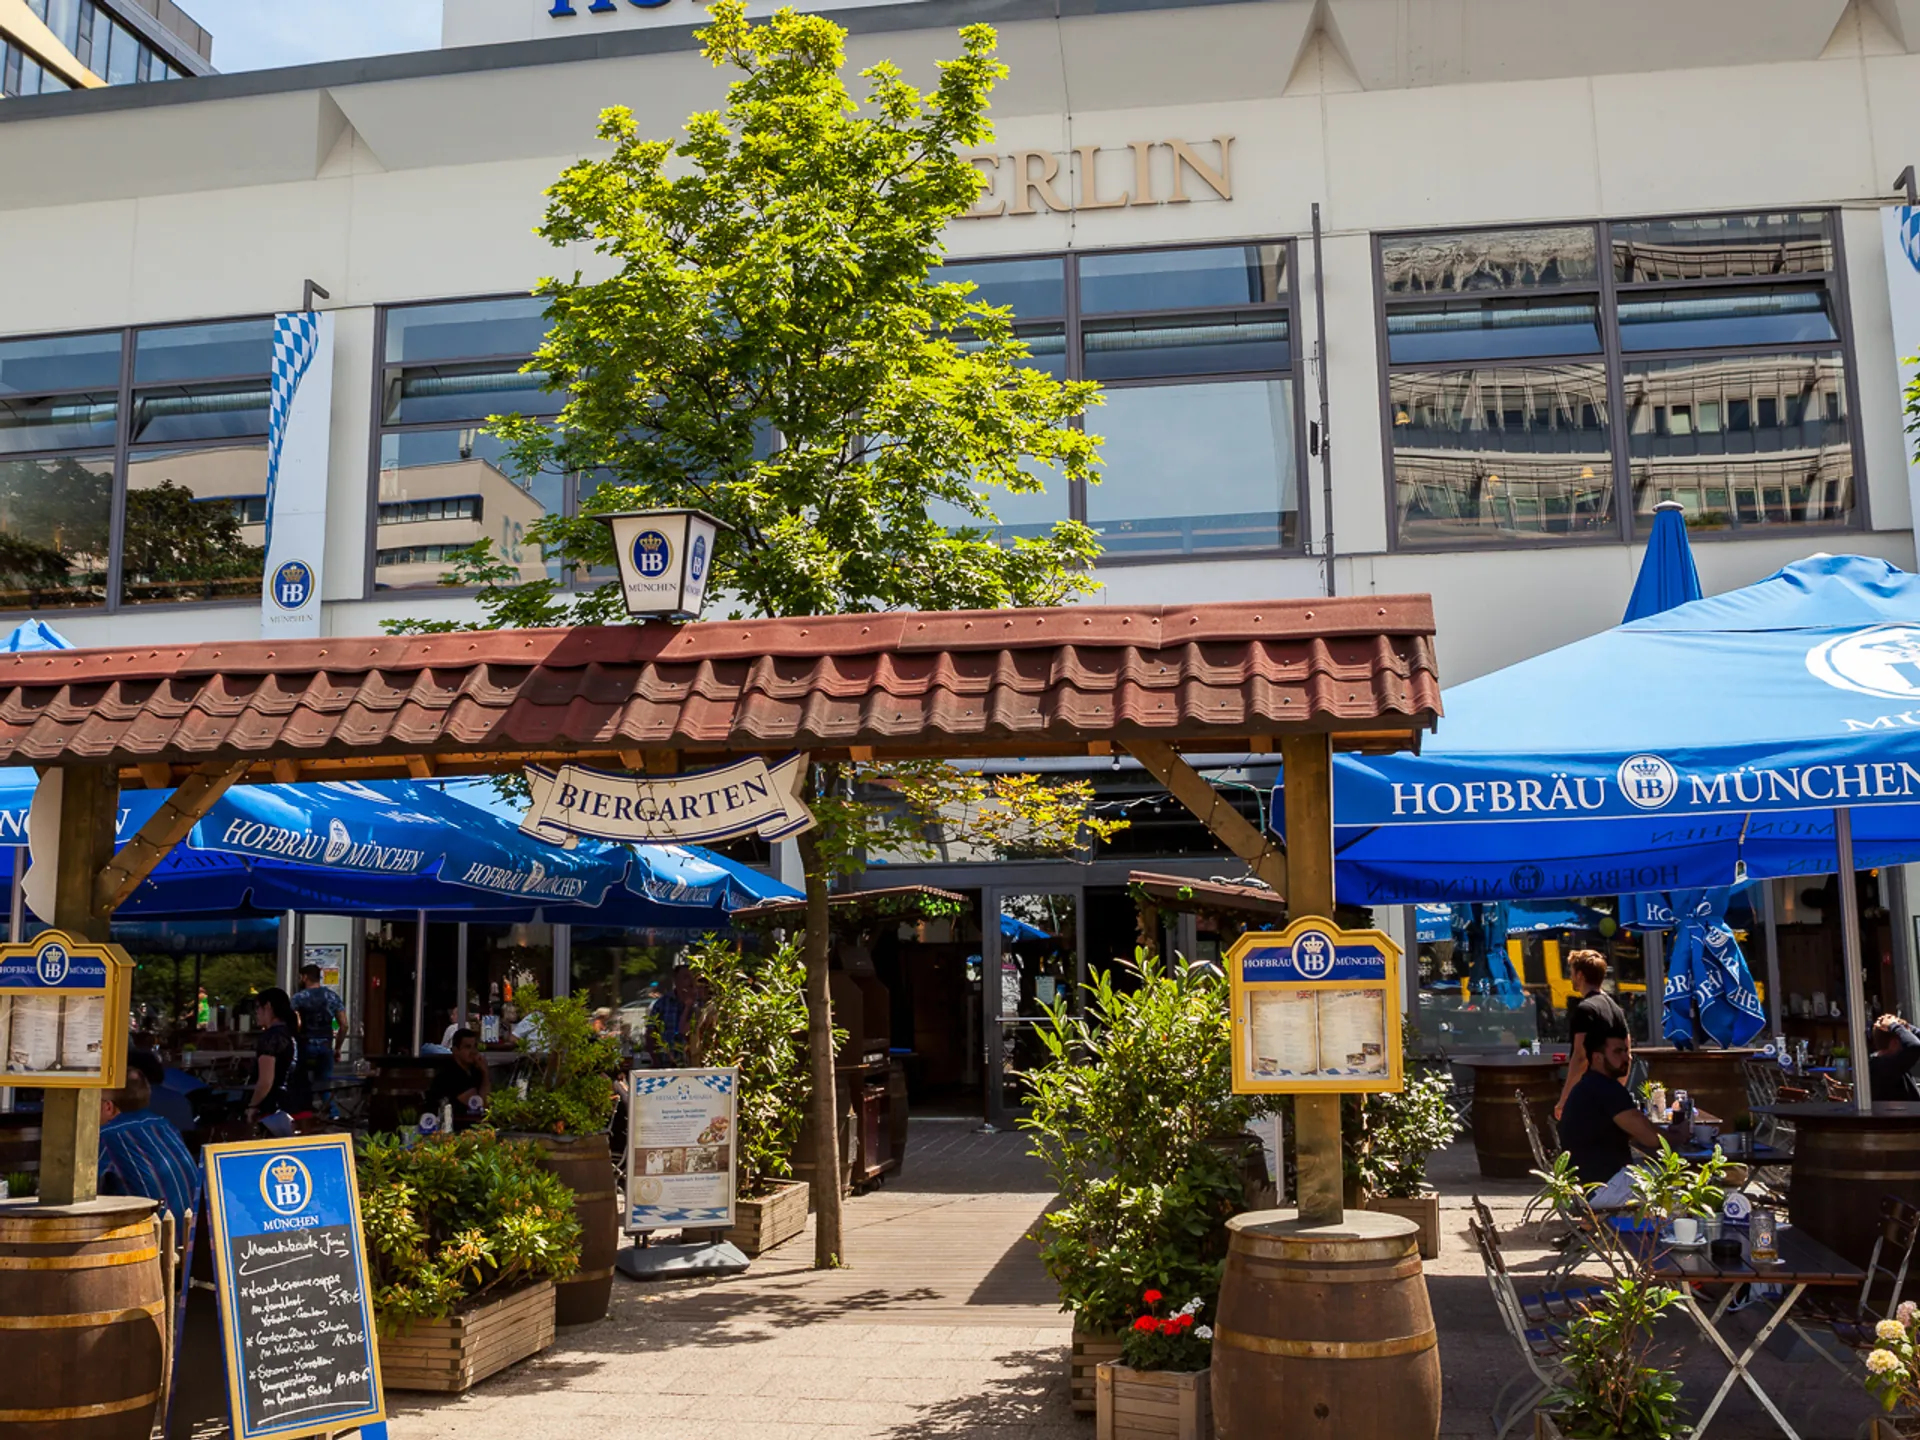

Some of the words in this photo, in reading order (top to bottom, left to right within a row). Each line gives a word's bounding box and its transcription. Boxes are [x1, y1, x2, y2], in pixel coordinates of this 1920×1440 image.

[950, 136, 1236, 219] ERLIN
[641, 553, 663, 572] HB
[281, 583, 304, 603] HB
[628, 582, 677, 593] MÜNCHEN
[555, 774, 769, 822] BIERGARTEN
[1390, 773, 1607, 815] HOFBRÄU
[1635, 777, 1665, 800] HB
[1687, 762, 1920, 805] MÜNCHEN
[222, 817, 326, 860] HOFBRÄU
[342, 840, 425, 872] MÜNCHEN
[461, 862, 527, 891] HOFBRÄU
[45, 963, 61, 978] HB
[69, 965, 106, 975] MÜNCHEN
[1243, 958, 1292, 968] HOFBRÄU
[1304, 955, 1325, 971] HB
[1335, 956, 1385, 966] MÜNCHEN
[274, 1182, 301, 1206] HB
[263, 1215, 319, 1231] MÜNCHEN
